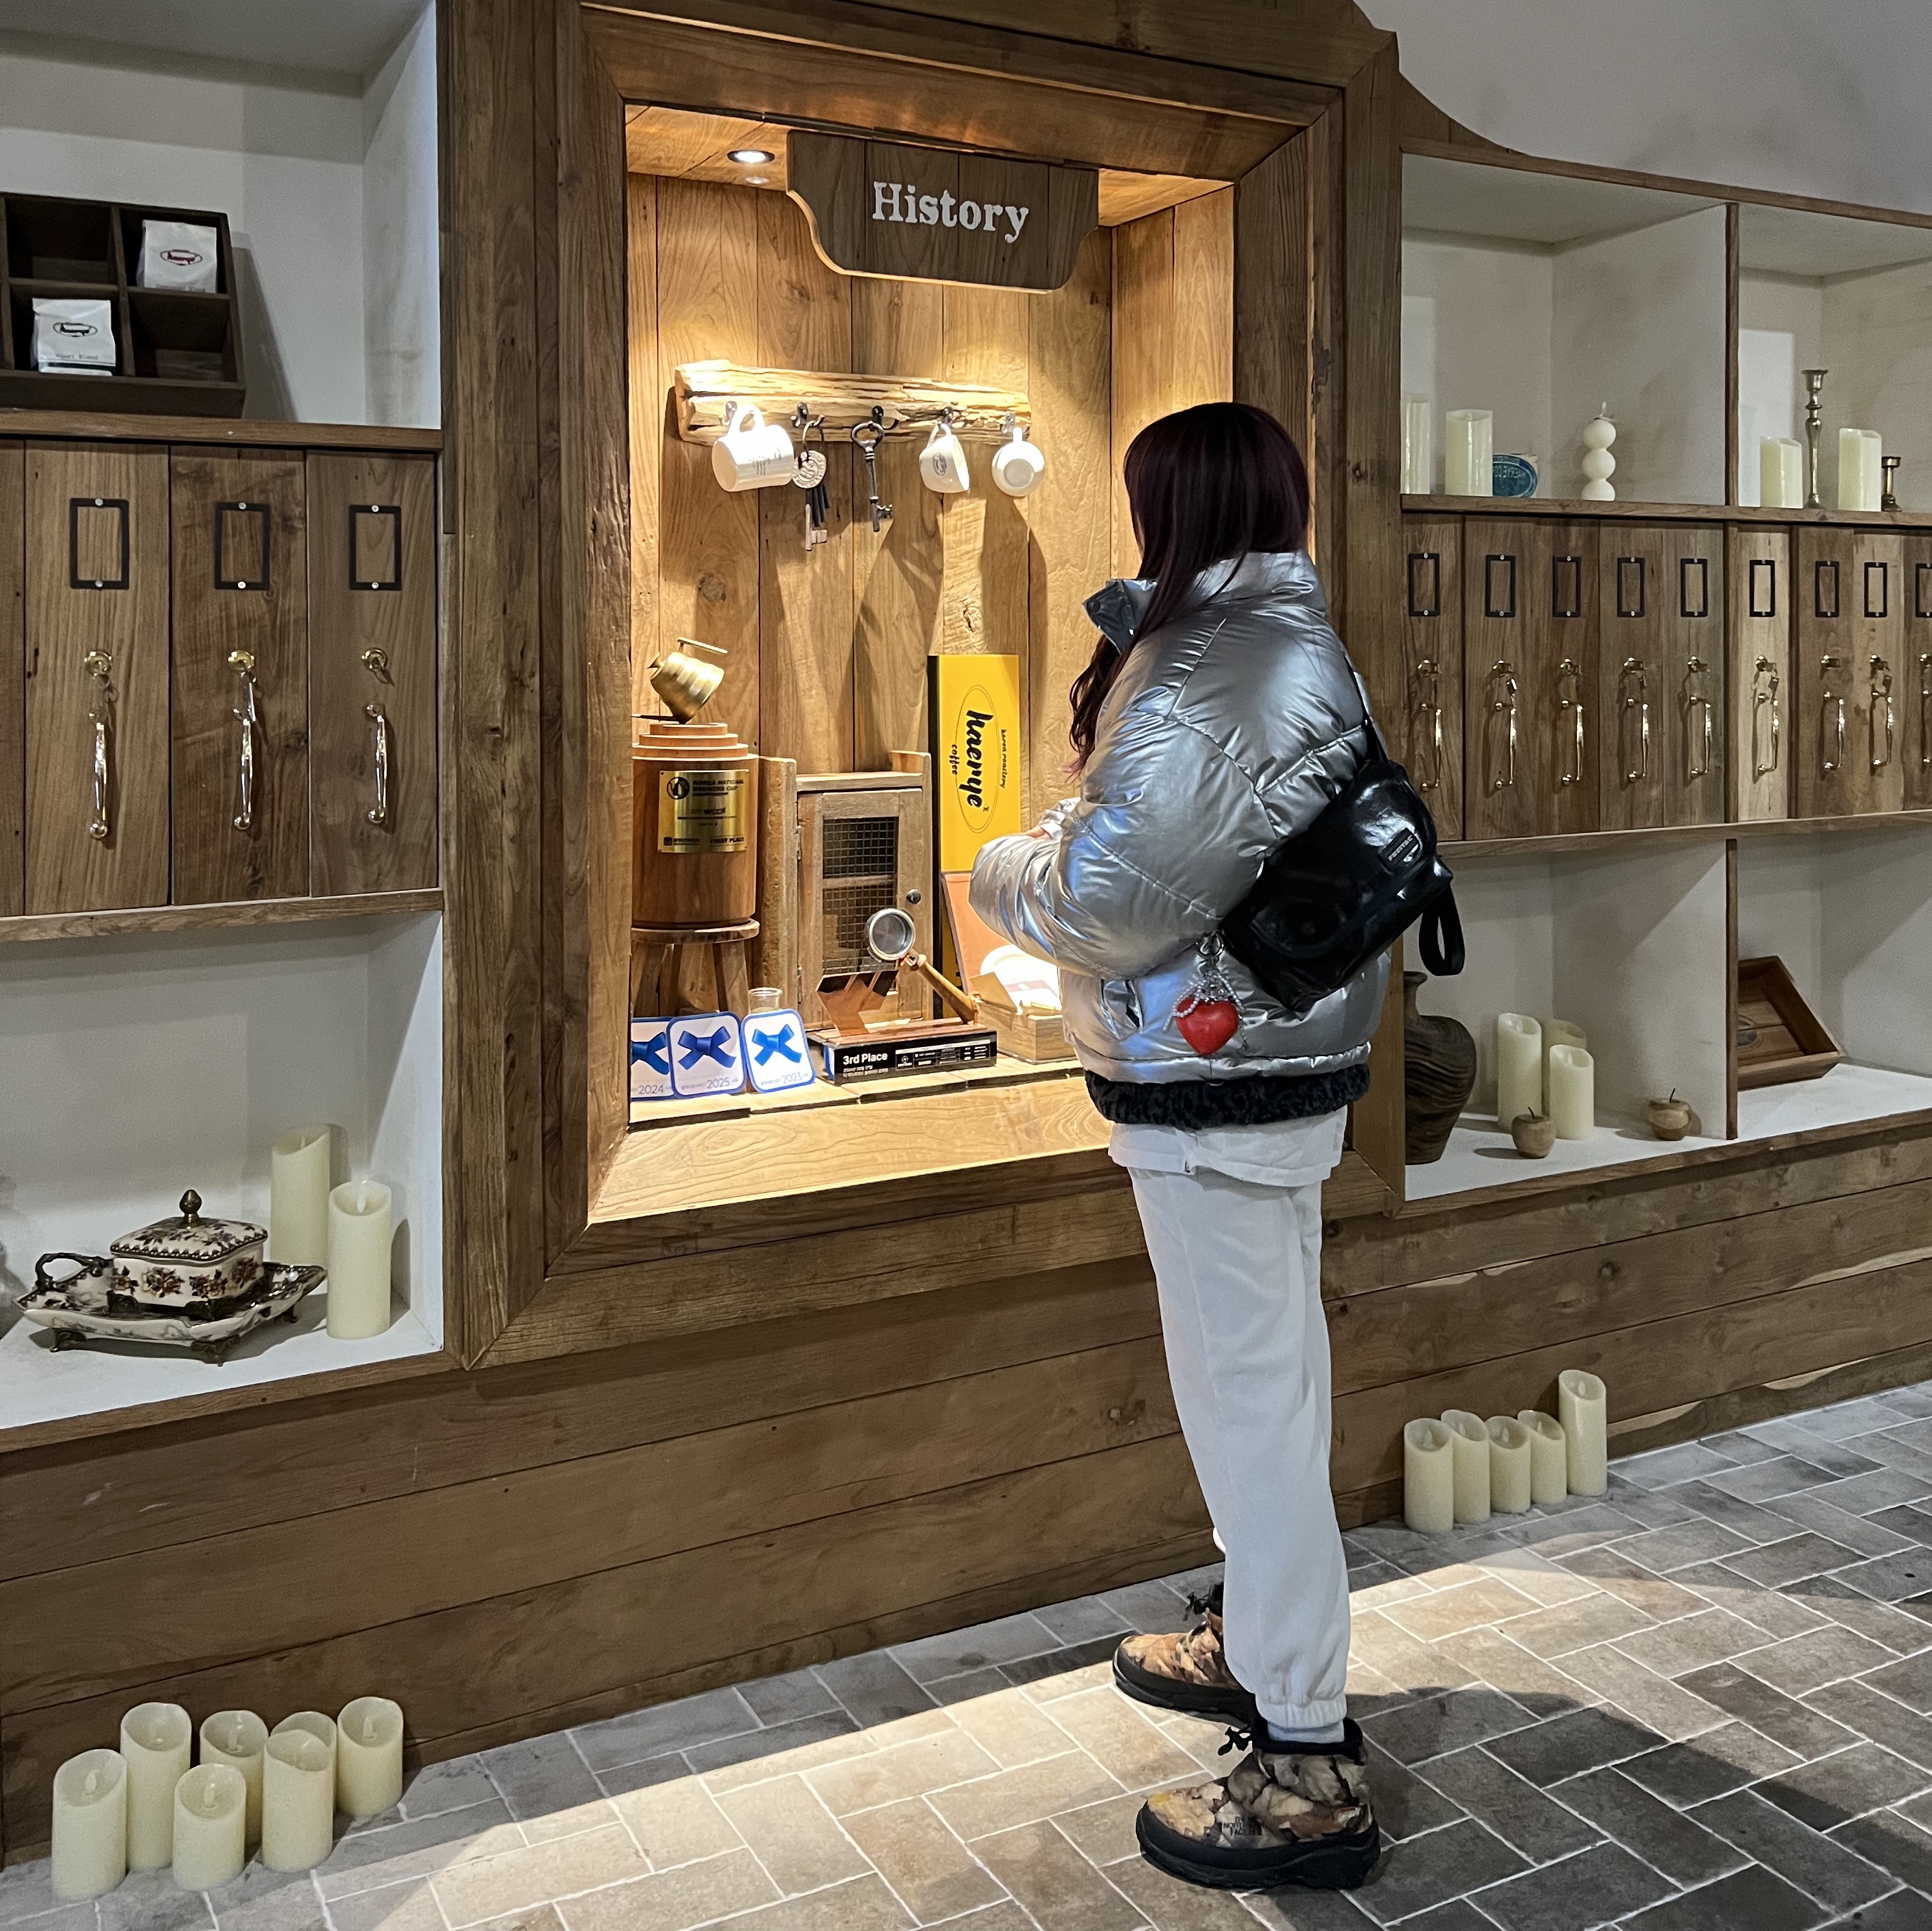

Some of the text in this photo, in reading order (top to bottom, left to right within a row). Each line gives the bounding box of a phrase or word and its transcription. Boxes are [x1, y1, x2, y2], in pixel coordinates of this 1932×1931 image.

[873, 180, 1030, 244] History
[949, 744, 961, 776] coffee
[959, 709, 994, 808] haerye
[843, 1053, 888, 1065] 3rd Place
[706, 1077, 731, 1090] 2025
[781, 1072, 803, 1084] 2023
[638, 1084, 664, 1095] 2024
